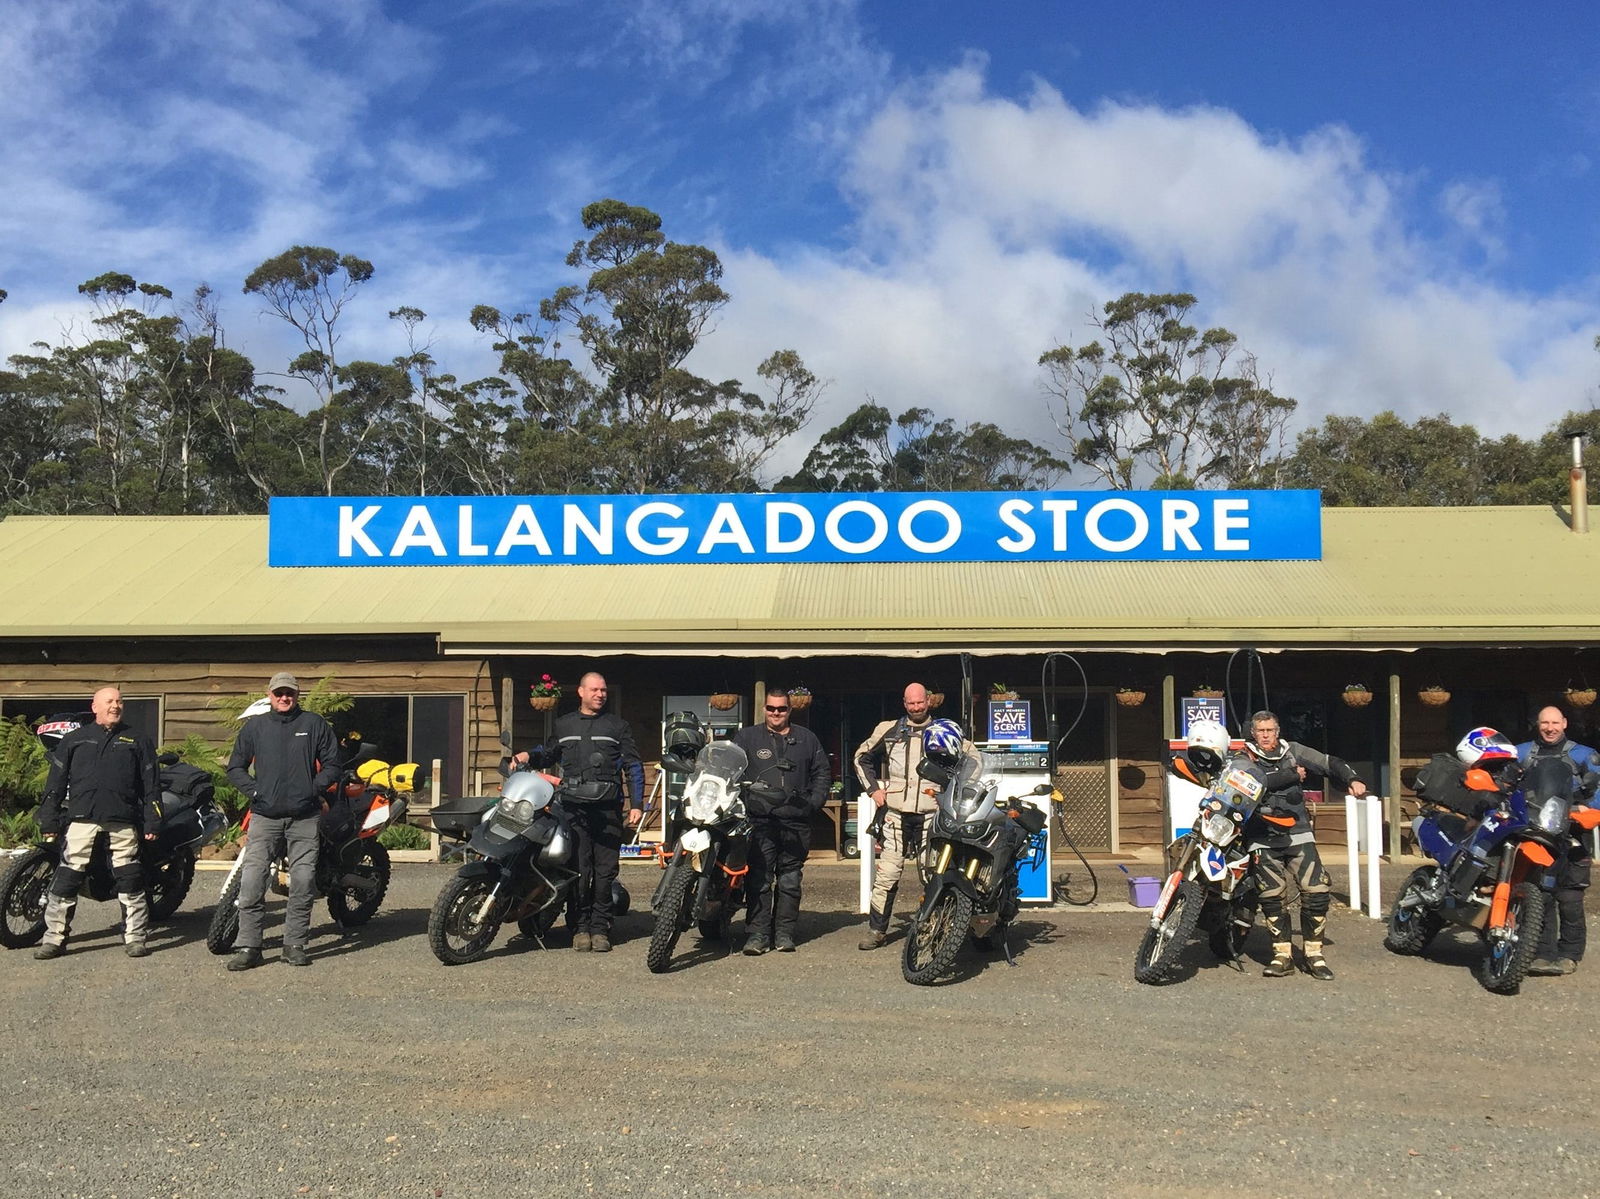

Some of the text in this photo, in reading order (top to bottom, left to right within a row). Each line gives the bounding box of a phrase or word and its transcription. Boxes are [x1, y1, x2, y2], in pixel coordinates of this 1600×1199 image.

[338, 499, 1250, 556] KALANGADOO STORE
[994, 713, 1026, 723] SAVE
[1187, 710, 1220, 720] SAVE
[1040, 758, 1047, 766] 2
